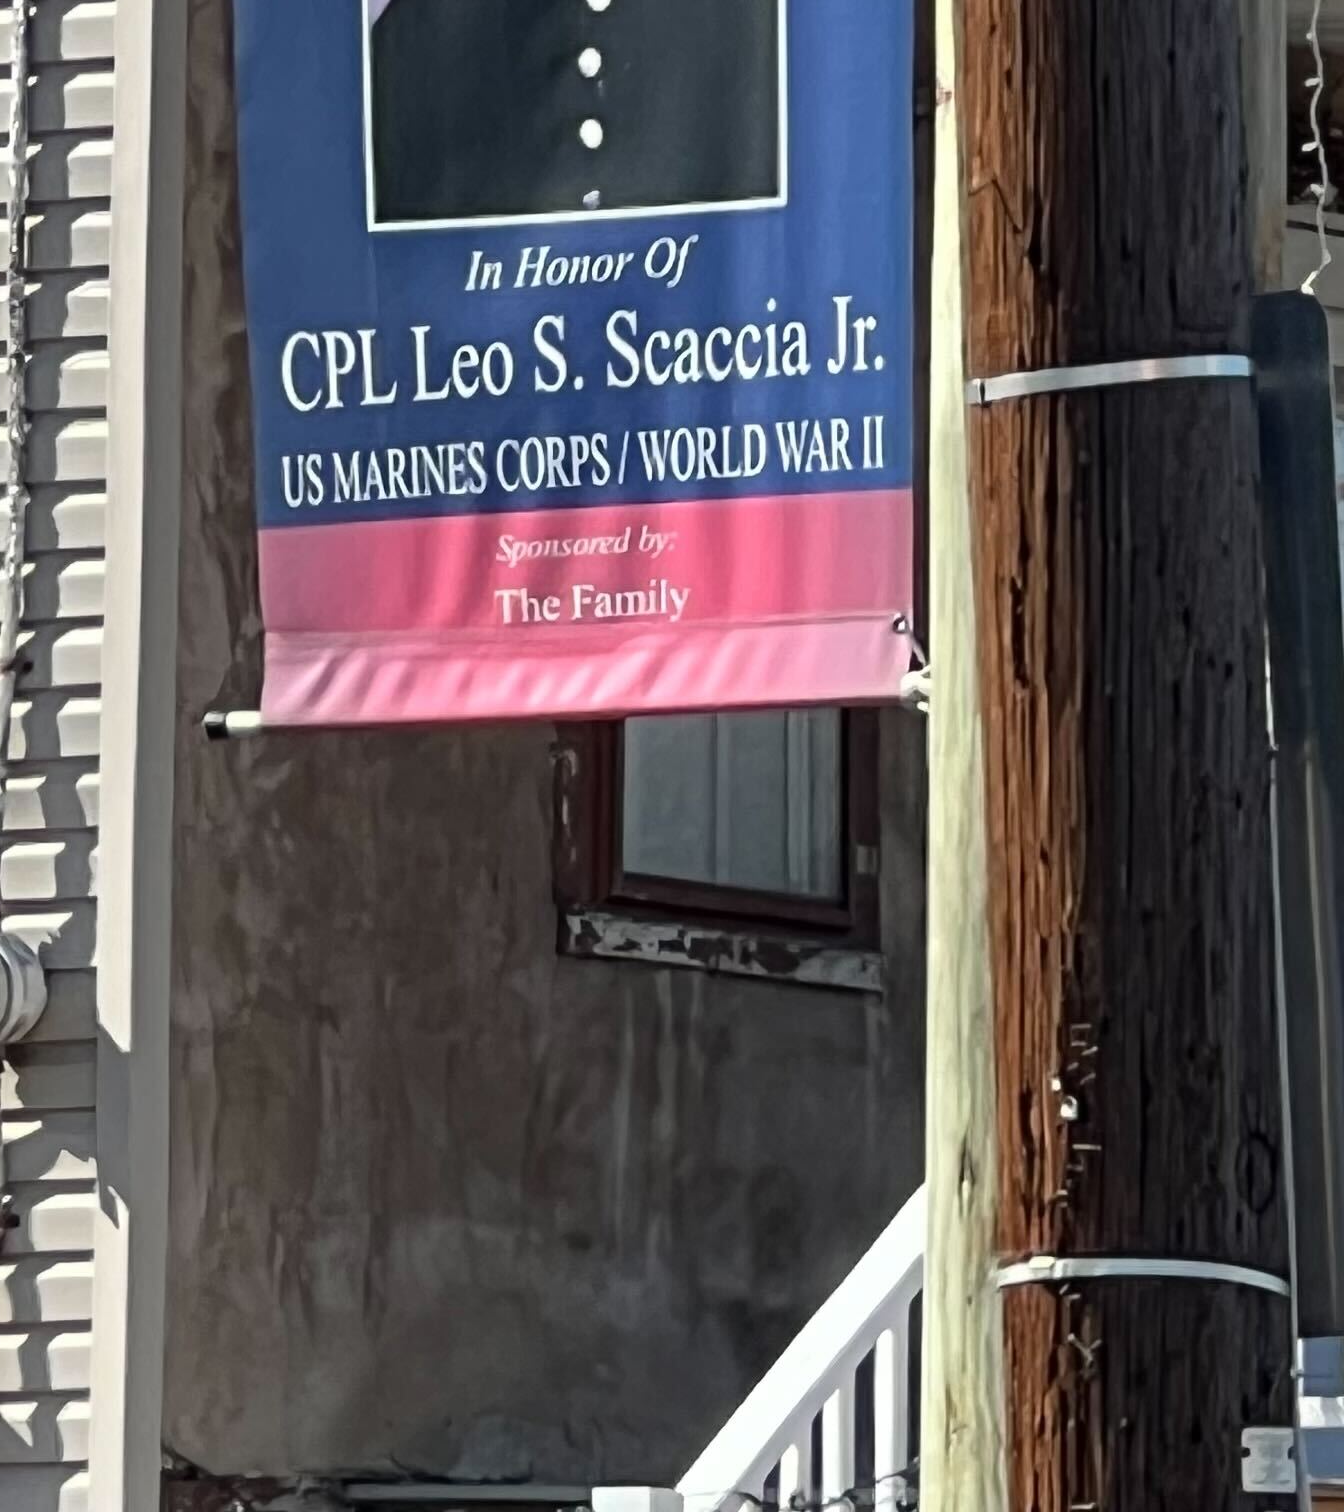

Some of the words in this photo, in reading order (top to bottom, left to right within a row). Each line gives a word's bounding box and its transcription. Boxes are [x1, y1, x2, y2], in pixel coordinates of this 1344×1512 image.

[465, 251, 501, 291] In
[514, 247, 634, 288] Honor
[645, 234, 698, 287] Of
[281, 328, 397, 412] CPL
[410, 325, 513, 401] Leo
[534, 315, 583, 393] S.
[606, 298, 811, 389] Scaccia
[827, 295, 884, 374] Jr.
[282, 453, 324, 507] US
[334, 441, 487, 504] MARINES
[496, 432, 609, 491] CORPS
[637, 424, 767, 482] WORLD
[776, 418, 854, 473] WAR
[861, 416, 884, 469] II
[496, 526, 630, 567] Sponsored
[639, 525, 675, 558] by:
[494, 586, 561, 624] The
[570, 579, 689, 623] Family
